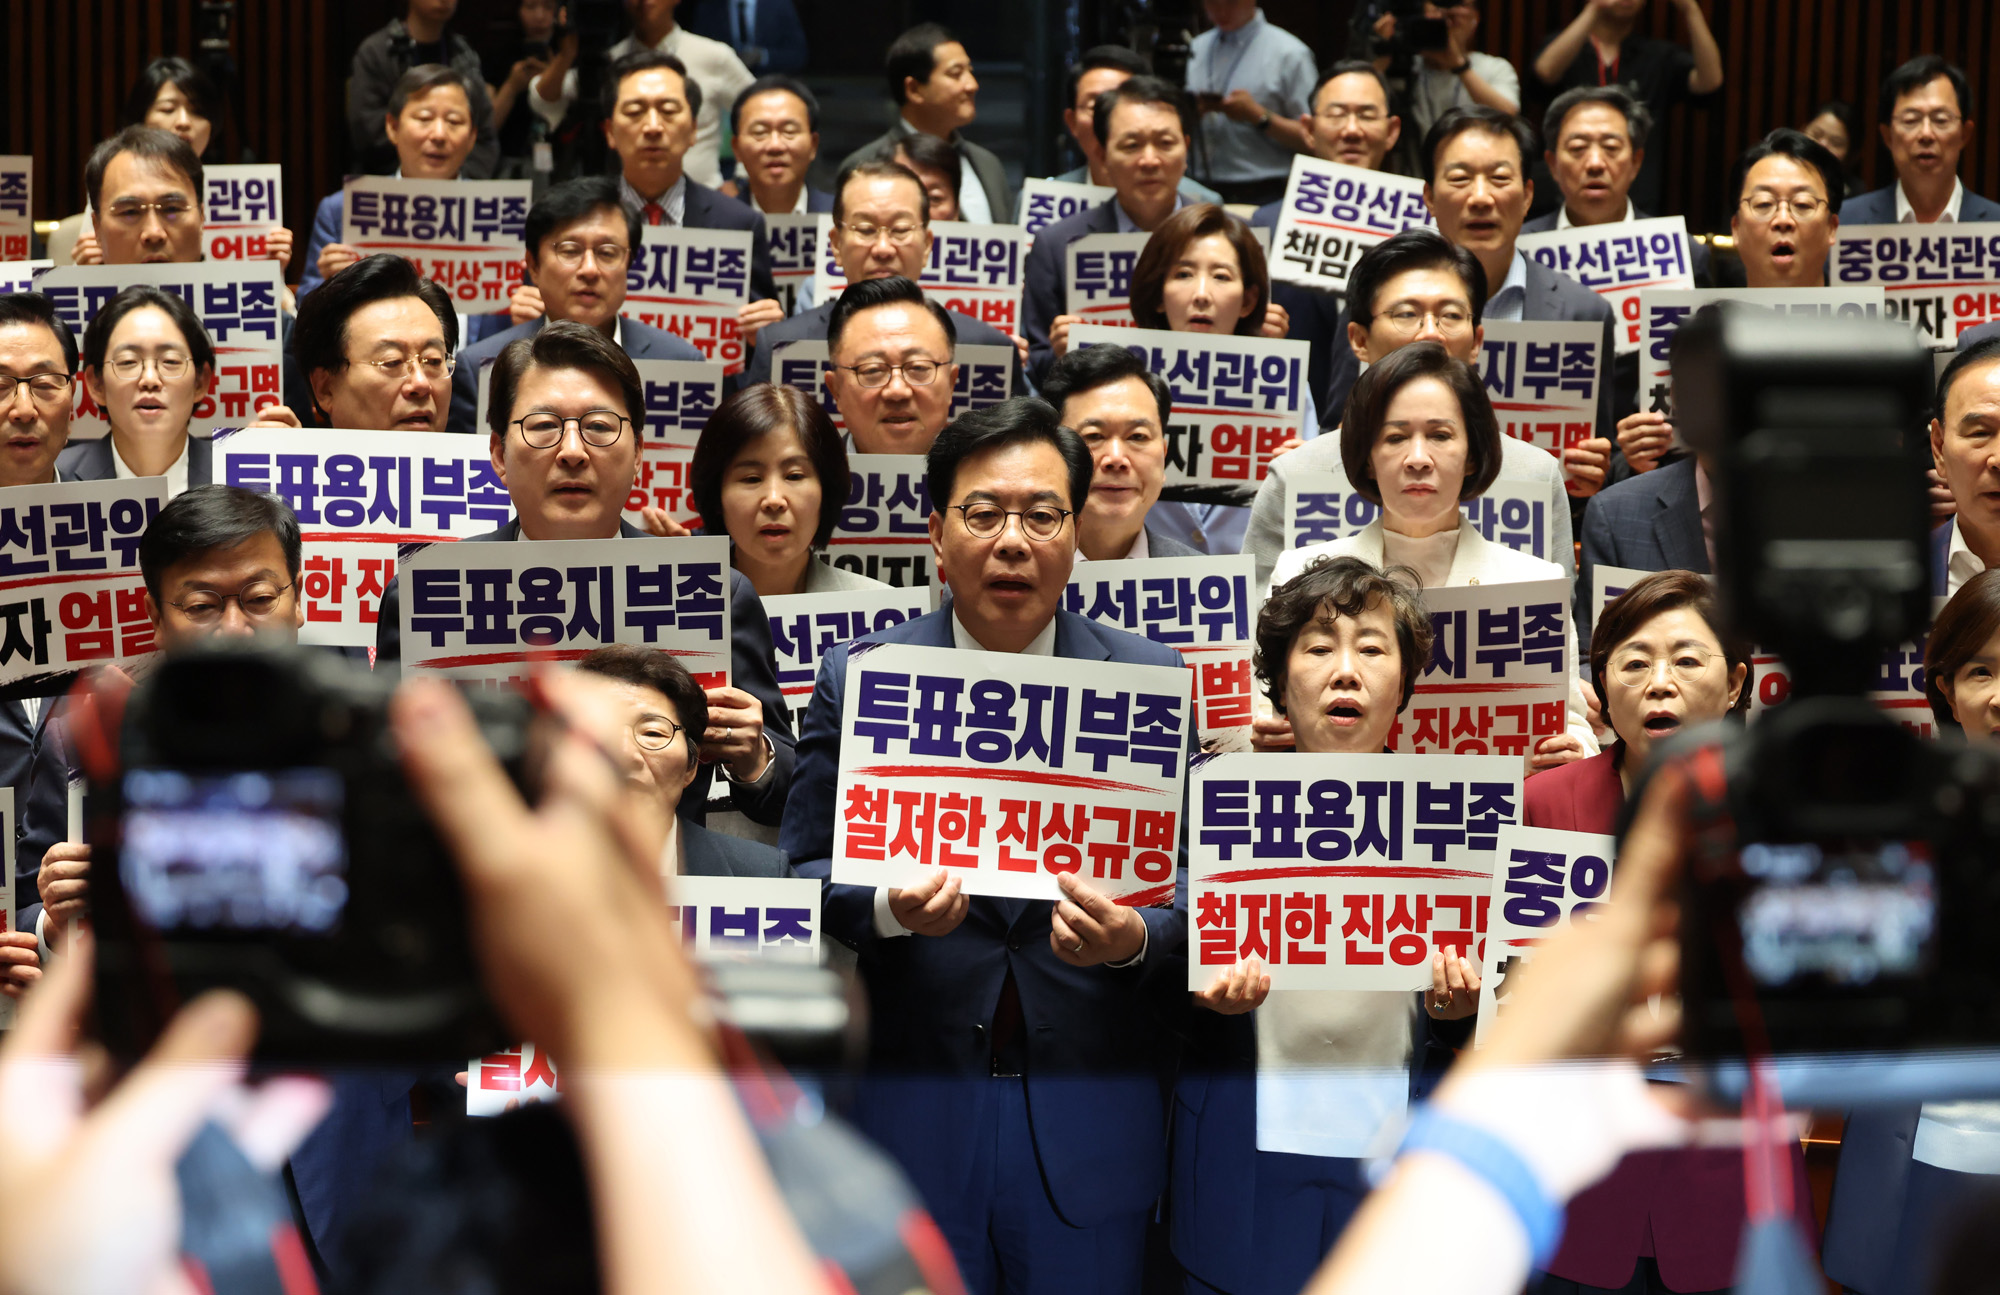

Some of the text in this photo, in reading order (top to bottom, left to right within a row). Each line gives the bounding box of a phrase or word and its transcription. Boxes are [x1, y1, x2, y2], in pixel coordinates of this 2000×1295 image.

[350, 191, 526, 242] 투표용지 부족
[1294, 170, 1432, 232] 중앙선관
[684, 246, 746, 297] 부족
[1075, 251, 1137, 299] 투표
[1283, 228, 1376, 280] 책임
[203, 281, 277, 342] 부족
[1079, 342, 1300, 411] 선관위
[1522, 342, 1595, 399] 부족
[645, 381, 716, 438] 부족
[421, 457, 511, 530] 부족
[0, 498, 159, 576] 선관위
[411, 566, 615, 647] 투표용지
[625, 562, 725, 643] 부족
[1476, 602, 1565, 678] 부족
[854, 670, 1182, 778] 투표용지 부족
[844, 784, 1176, 882] 철저한 진상규명
[1200, 779, 1517, 862] 투표용지 부족
[1196, 891, 1332, 965] 철저한
